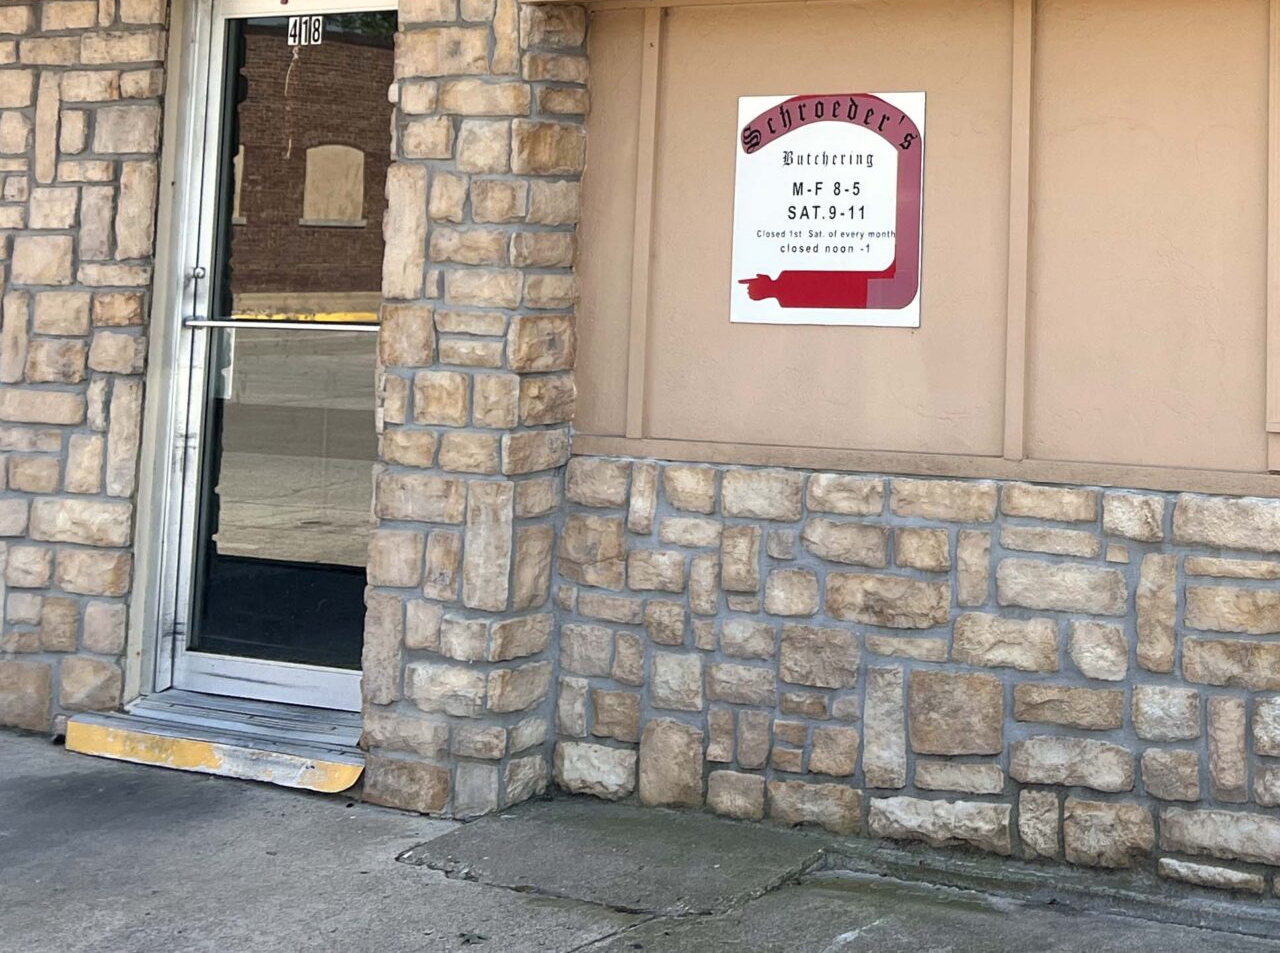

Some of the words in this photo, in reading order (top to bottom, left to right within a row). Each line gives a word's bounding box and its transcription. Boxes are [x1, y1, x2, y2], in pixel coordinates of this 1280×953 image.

[289, 17, 321, 44] 418
[742, 97, 917, 154] Schroeder's
[782, 150, 874, 168] Butchering
[792, 181, 824, 197] M-F
[833, 181, 861, 197] 8-5
[756, 230, 786, 239] Closed
[789, 230, 803, 238] 1st
[808, 229, 826, 238] Sat.
[828, 229, 838, 238] of
[840, 231, 865, 240] every
[867, 230, 896, 239] month
[779, 243, 819, 254] closed
[824, 245, 855, 254] noon
